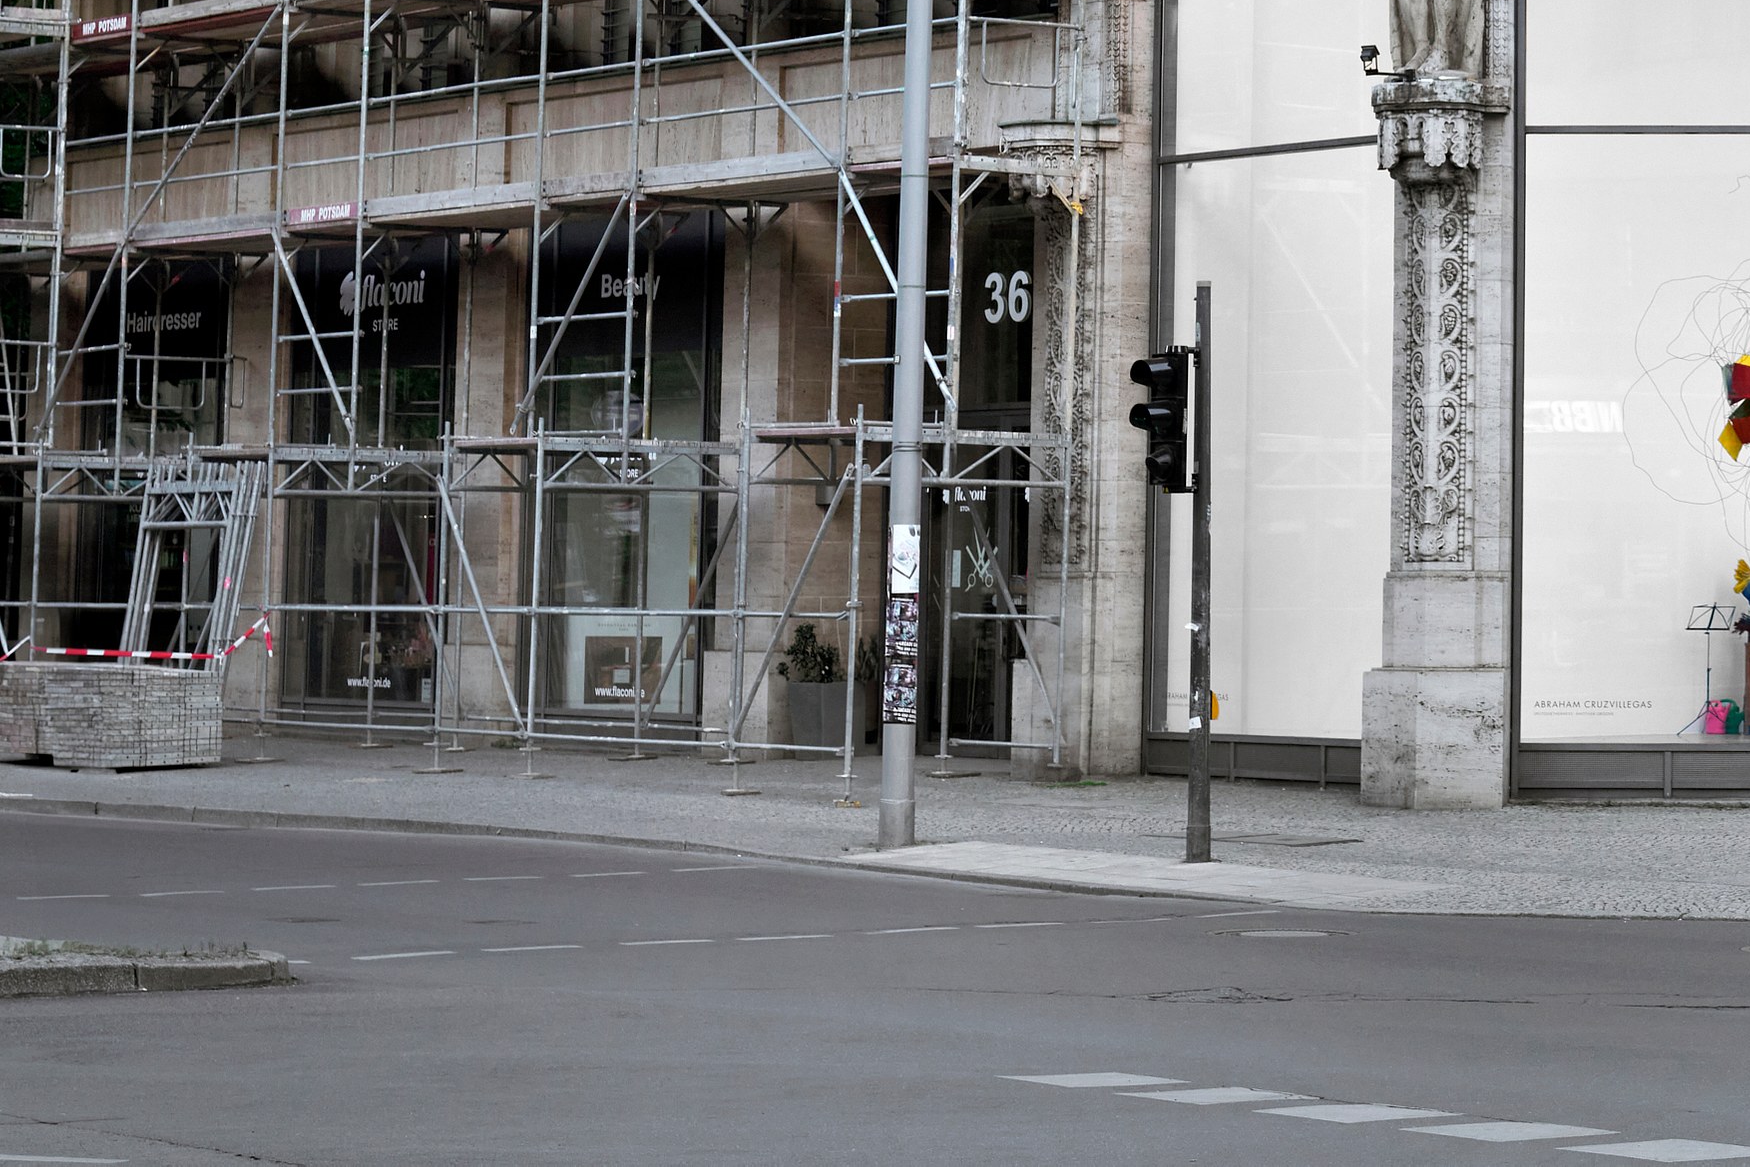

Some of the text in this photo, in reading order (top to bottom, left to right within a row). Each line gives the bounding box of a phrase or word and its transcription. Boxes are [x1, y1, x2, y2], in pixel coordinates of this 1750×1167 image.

[82, 16, 127, 36] MHP POTSDAM
[301, 204, 351, 222] MHP POTSDAM
[984, 270, 1031, 323] 36
[372, 318, 399, 332] STRE
[594, 685, 646, 698] www.flaconi.e
[1534, 699, 1653, 709] ABRAHAM CRUZVILLEGAS
